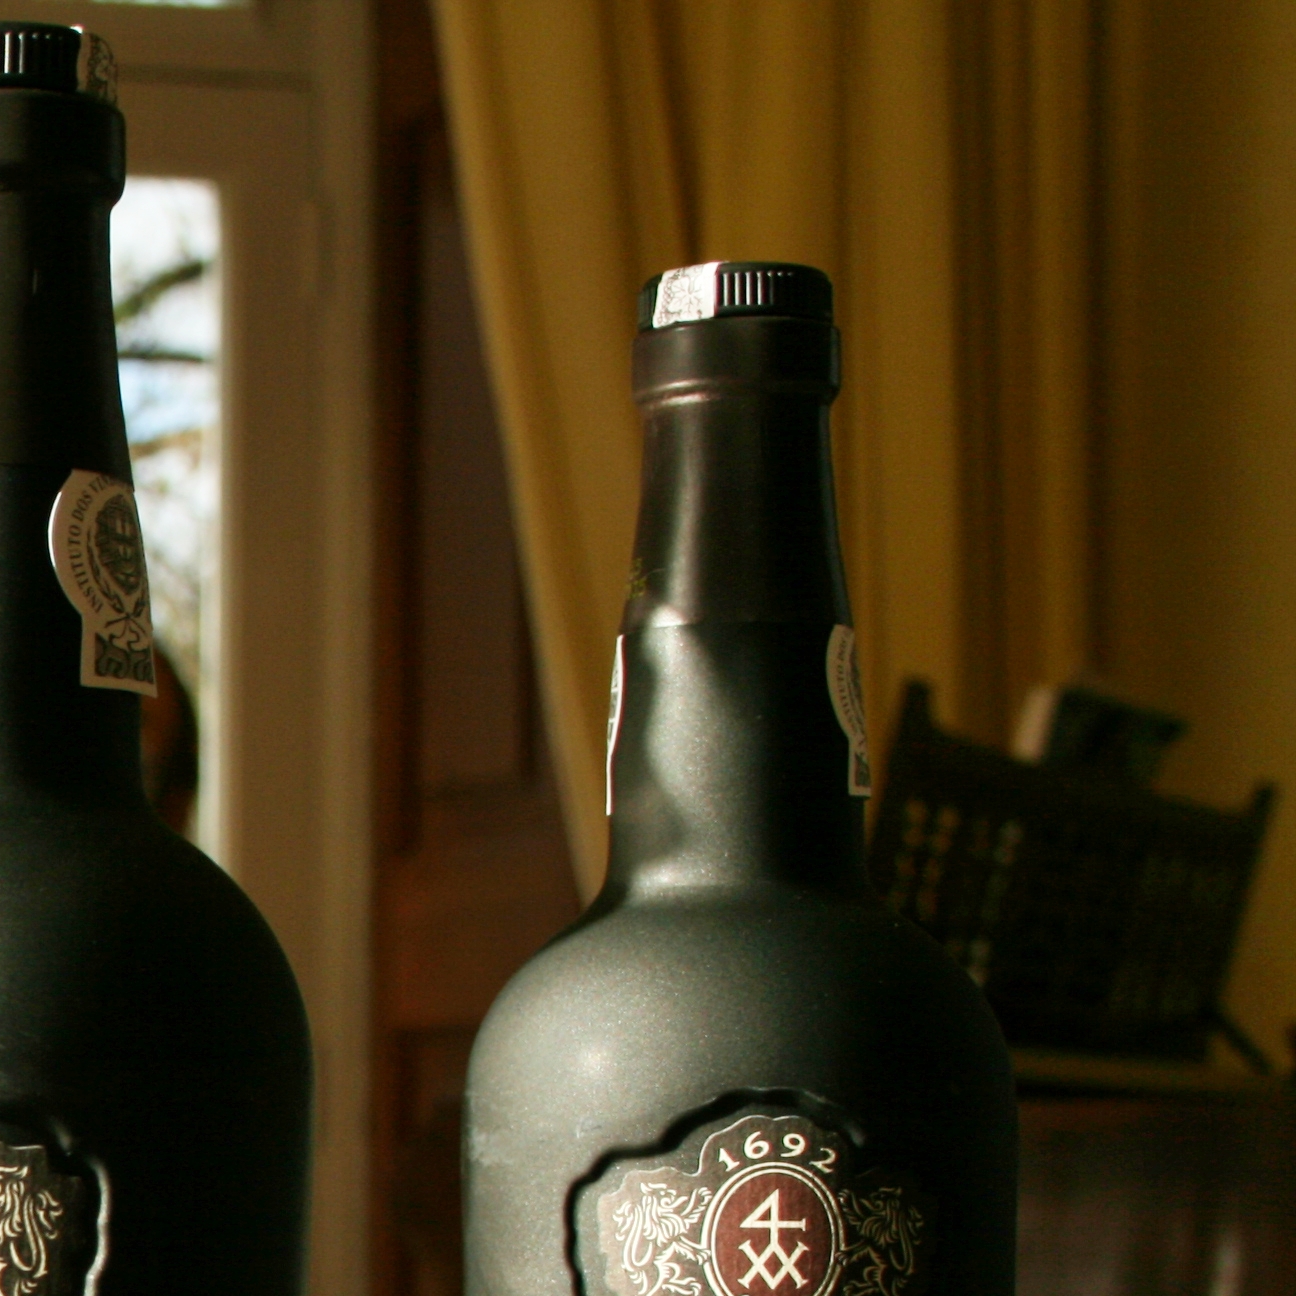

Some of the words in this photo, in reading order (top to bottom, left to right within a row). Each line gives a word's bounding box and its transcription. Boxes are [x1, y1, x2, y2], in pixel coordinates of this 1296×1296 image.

[71, 491, 95, 522] DOS
[68, 523, 104, 614] INSTITUTO
[718, 1131, 838, 1172] 1692
